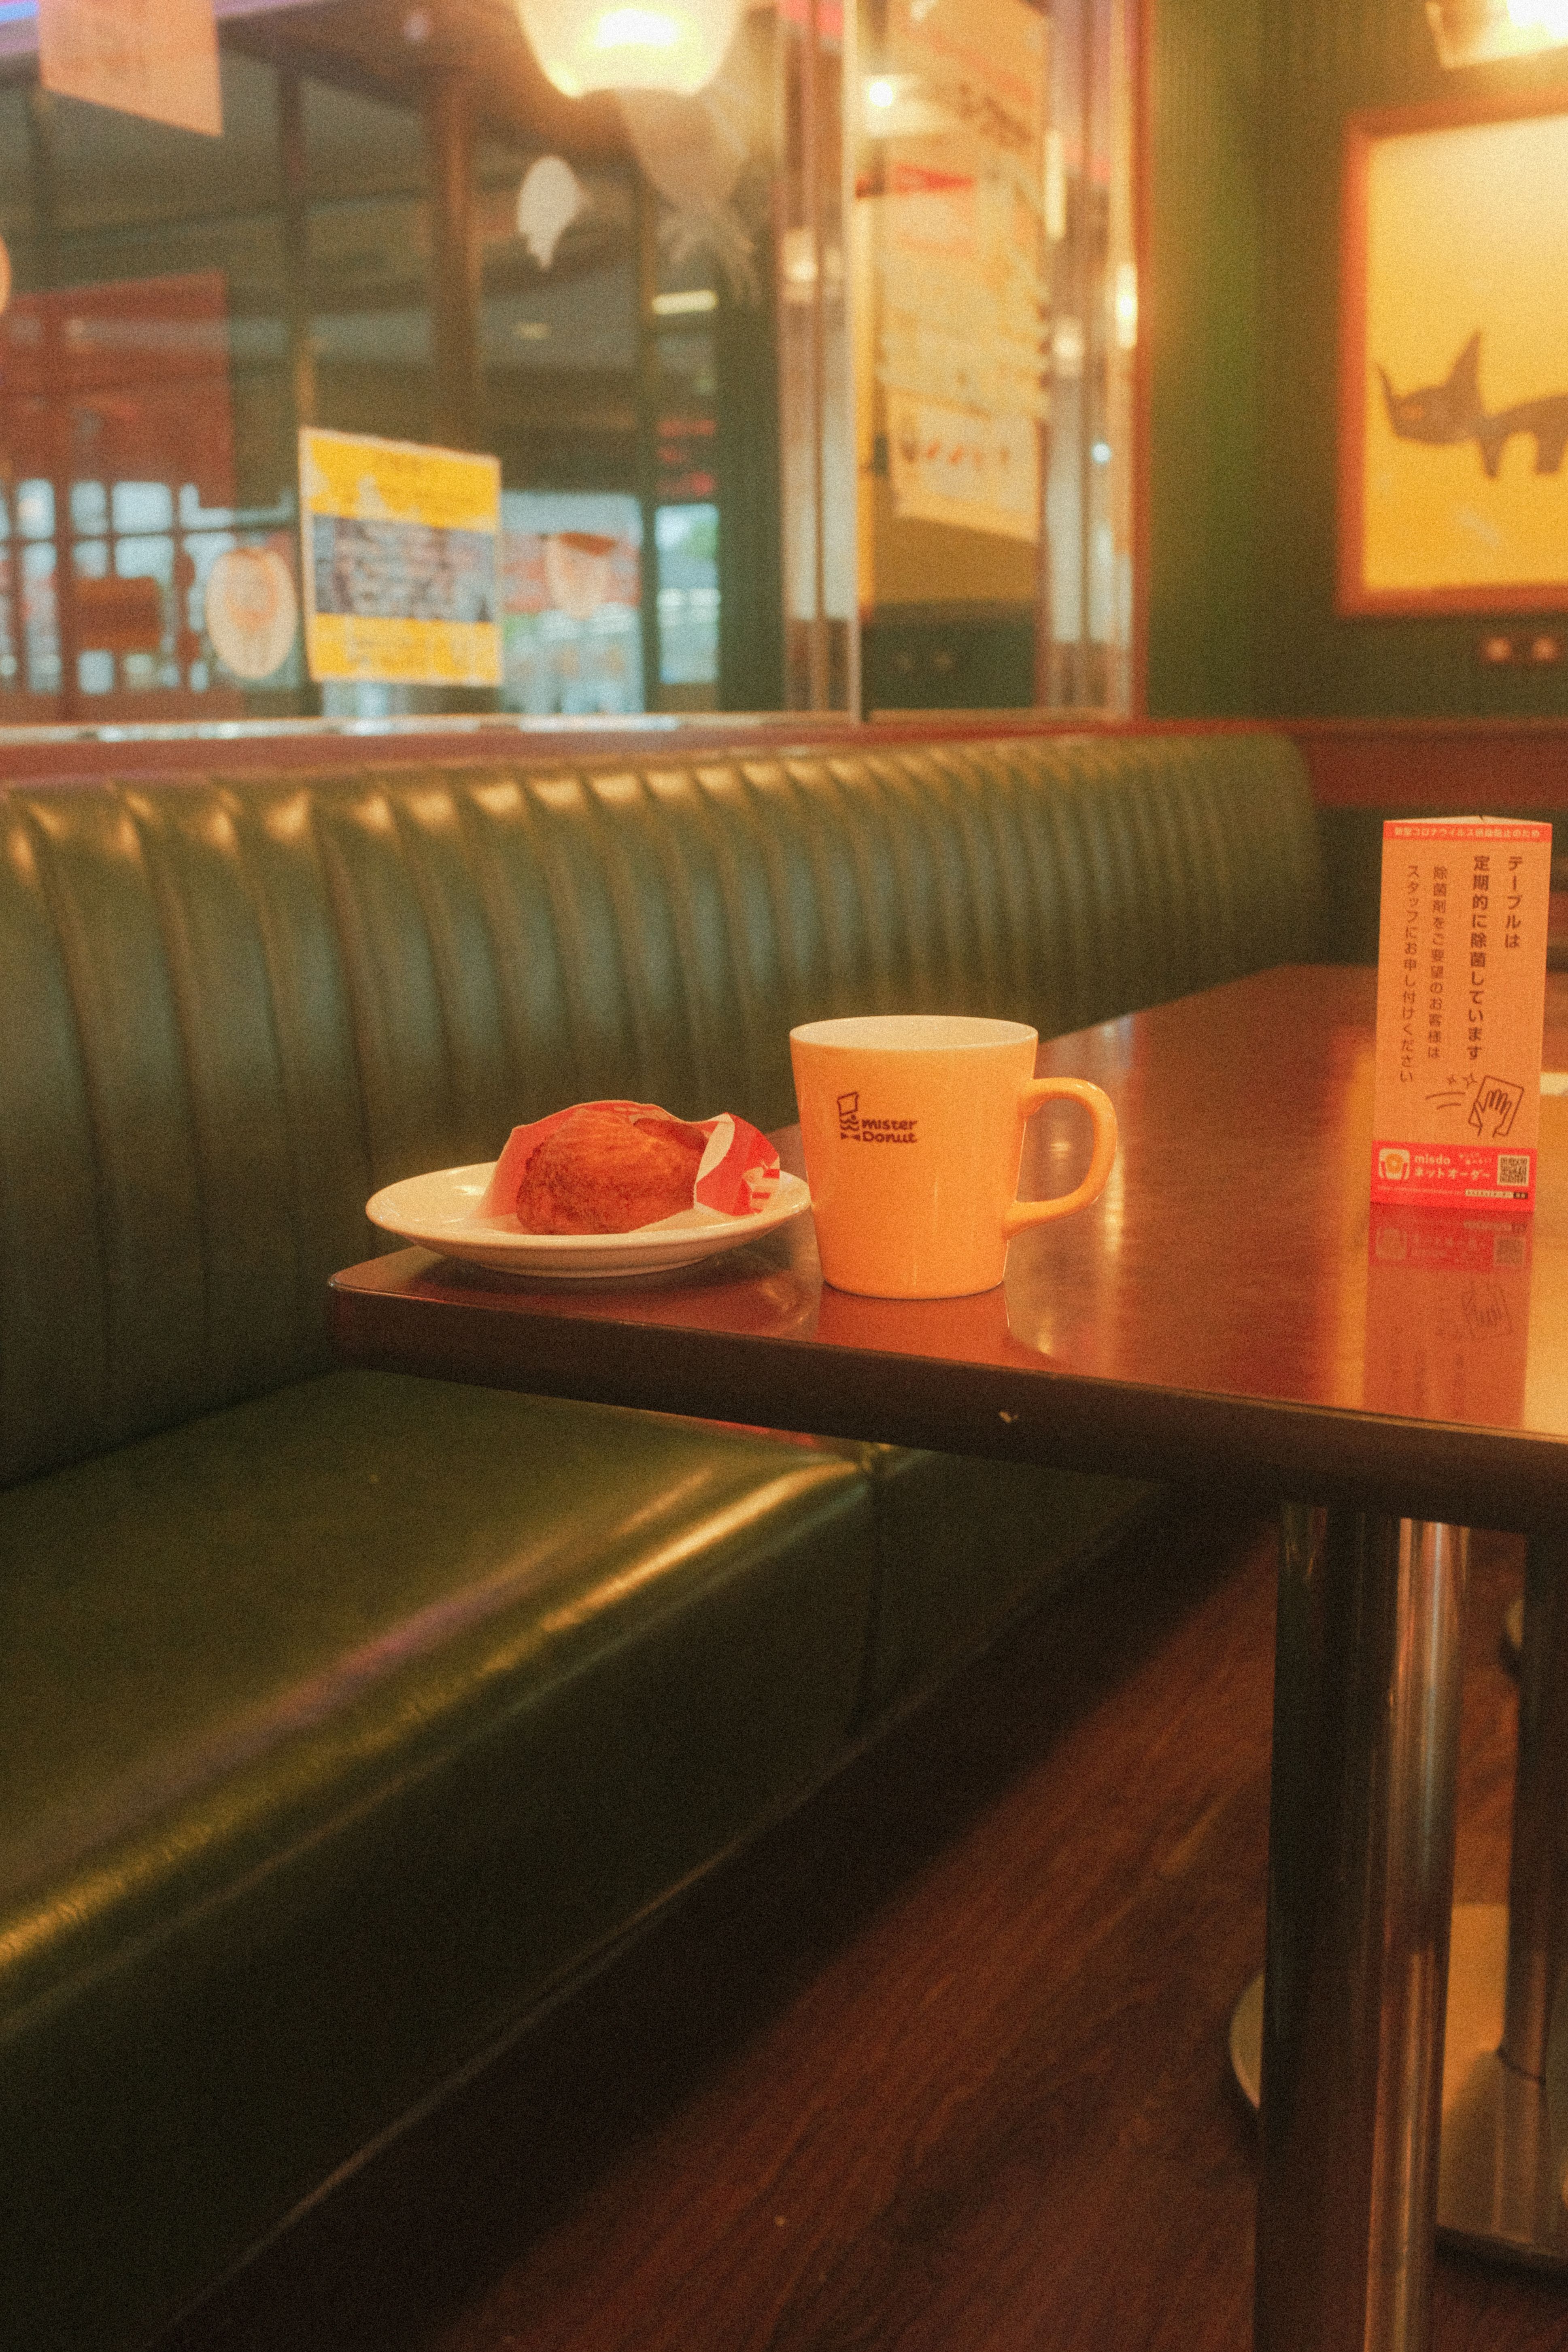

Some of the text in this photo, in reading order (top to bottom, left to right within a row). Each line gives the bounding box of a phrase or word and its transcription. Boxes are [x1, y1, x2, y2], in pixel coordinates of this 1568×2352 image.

[1505, 856, 1523, 948] テーブルは
[1400, 865, 1419, 1082] スタッフにお申し付けください
[1467, 855, 1490, 1060] 定期的に除菌しています
[863, 1131, 918, 1143] Donut
[1414, 1154, 1451, 1165] misdo
